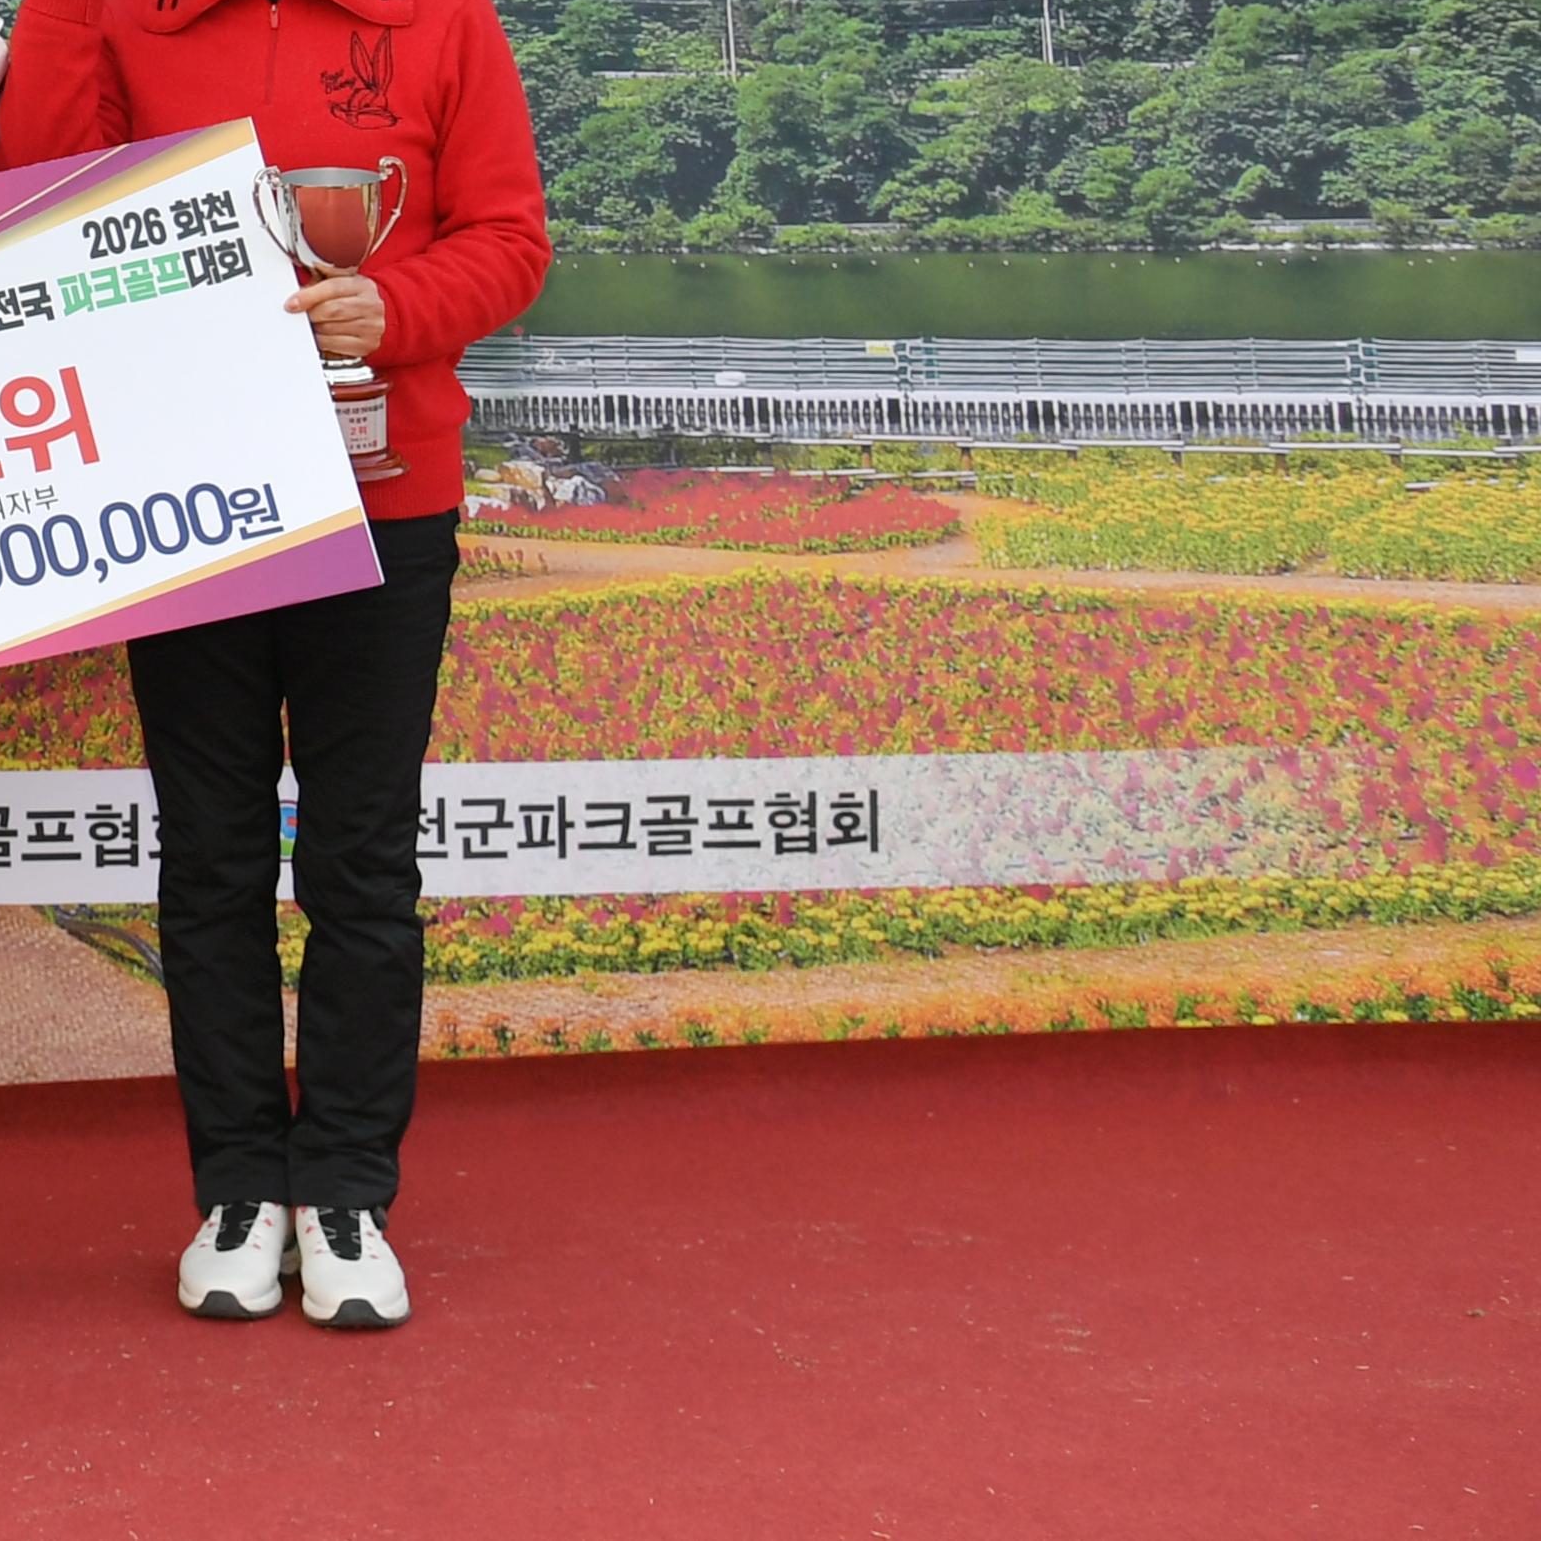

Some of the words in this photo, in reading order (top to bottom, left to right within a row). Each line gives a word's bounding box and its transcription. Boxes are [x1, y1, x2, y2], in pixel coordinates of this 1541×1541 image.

[81, 206, 167, 260] 2026
[168, 189, 240, 241] 화천
[56, 236, 254, 317] 파크골프대회
[417, 789, 881, 860] 천군파크골프협회
